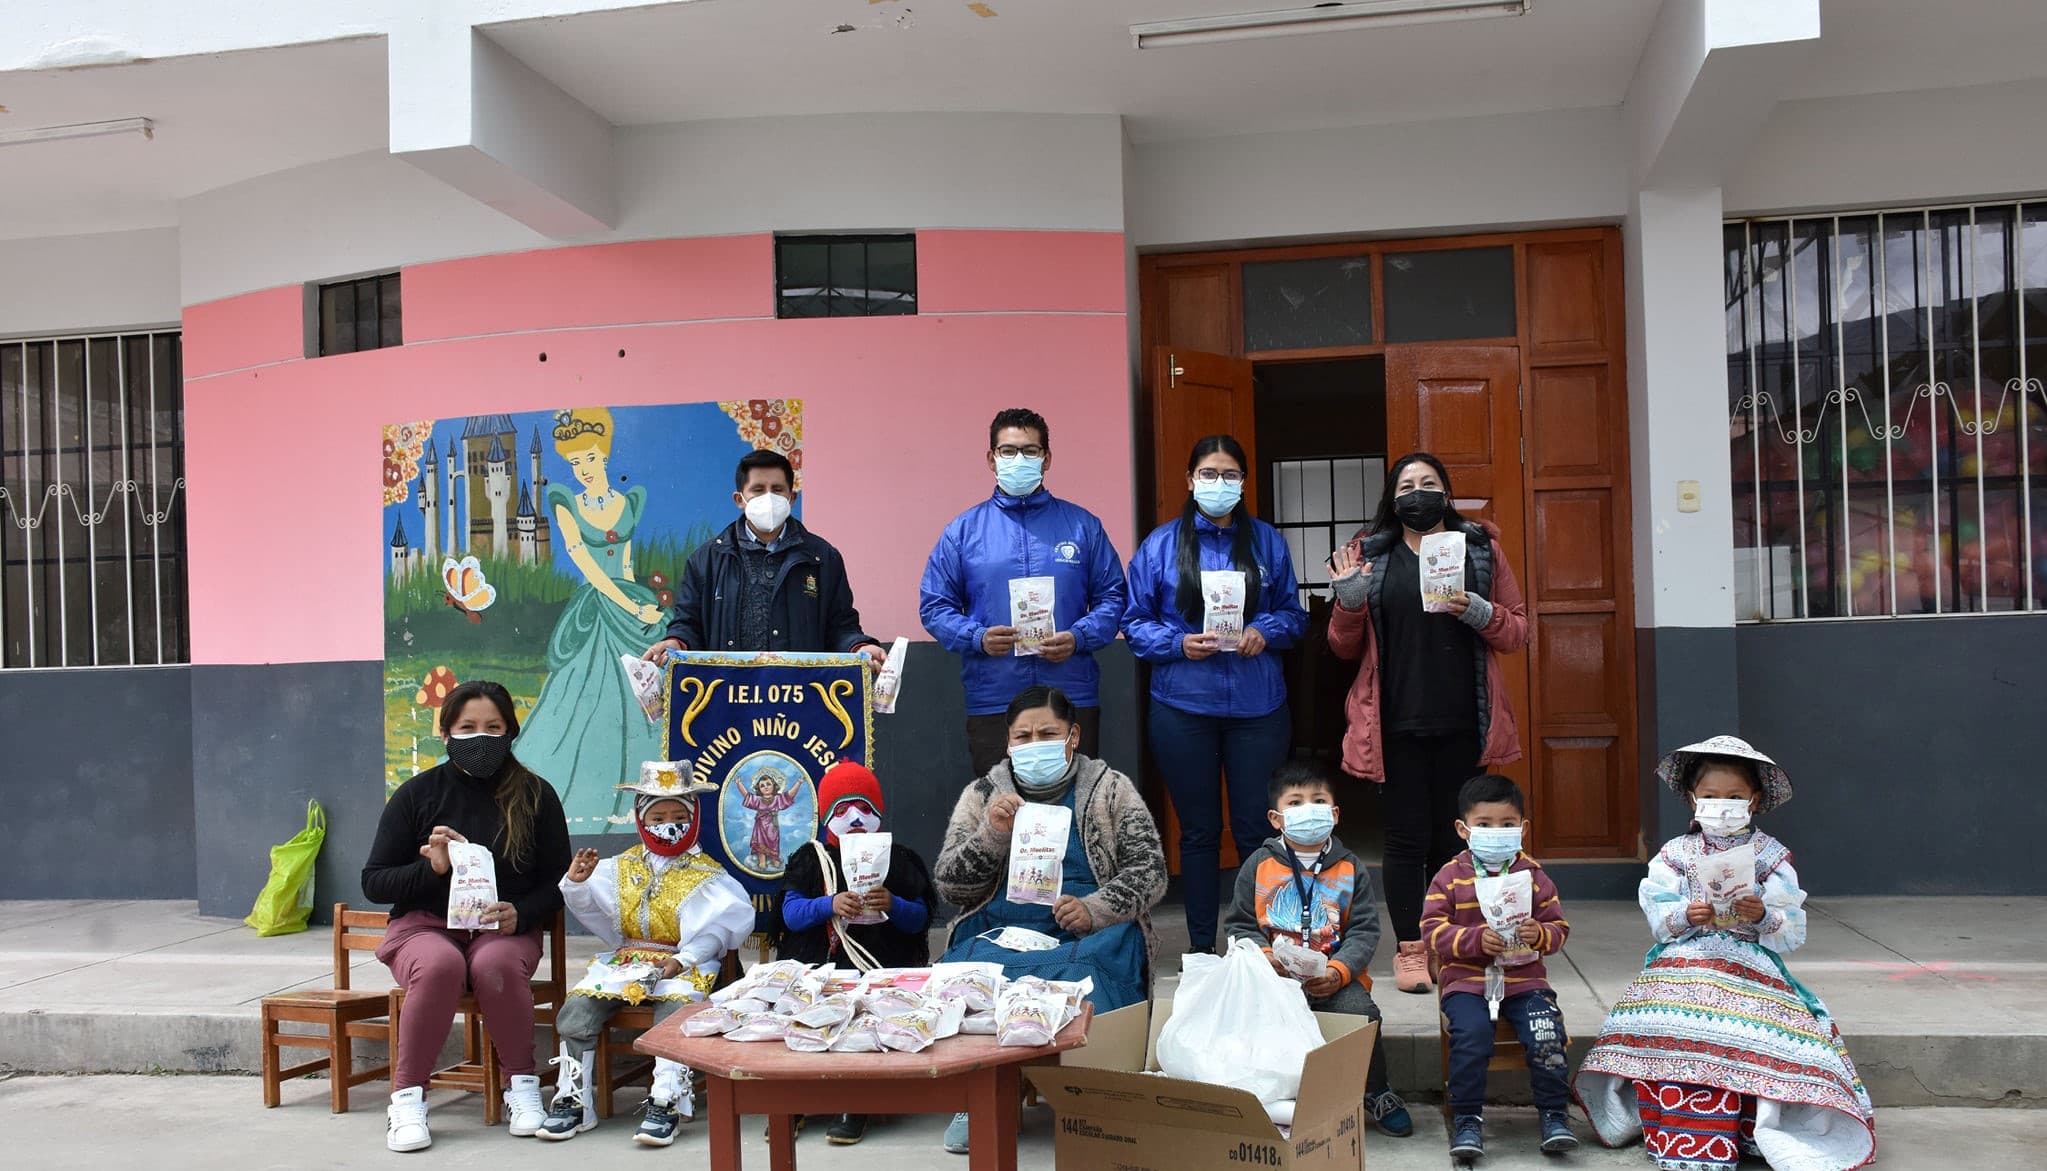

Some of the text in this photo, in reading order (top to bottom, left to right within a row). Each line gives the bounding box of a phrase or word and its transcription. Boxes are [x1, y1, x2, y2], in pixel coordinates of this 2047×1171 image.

[728, 684, 804, 704] I.E.I. 075
[693, 726, 742, 785] DIVINO
[752, 712, 800, 740] NIÑO
[1529, 1018, 1555, 1032] Little
[1535, 1030, 1557, 1041] dino
[1061, 1116, 1078, 1136] 144
[1239, 1142, 1277, 1166] 01418
